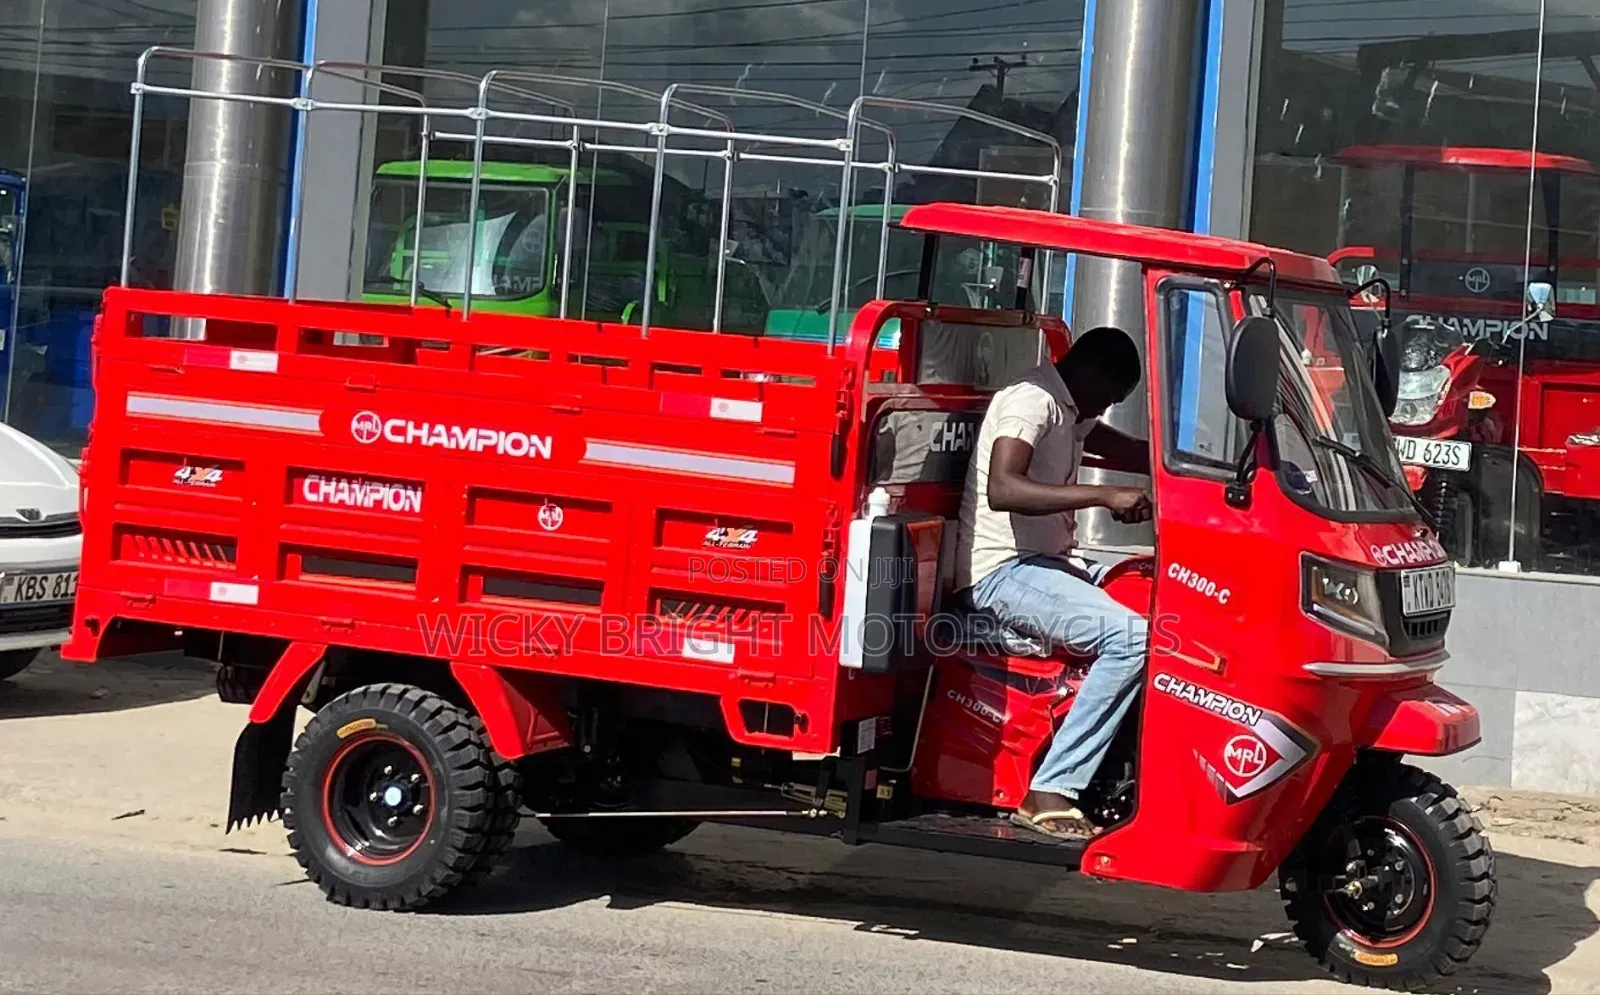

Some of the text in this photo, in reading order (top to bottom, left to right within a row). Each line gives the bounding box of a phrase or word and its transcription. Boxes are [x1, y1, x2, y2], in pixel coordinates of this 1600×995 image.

[383, 418, 553, 460] CHAMPION
[1423, 443, 1461, 466] 623S
[303, 475, 422, 513] CHAMPION
[14, 576, 49, 601] KBS
[1167, 562, 1232, 605] CH300-C
[946, 689, 1002, 723] CH300-C
[1153, 672, 1263, 726] CHAMPION
[1224, 735, 1267, 778] MRL
